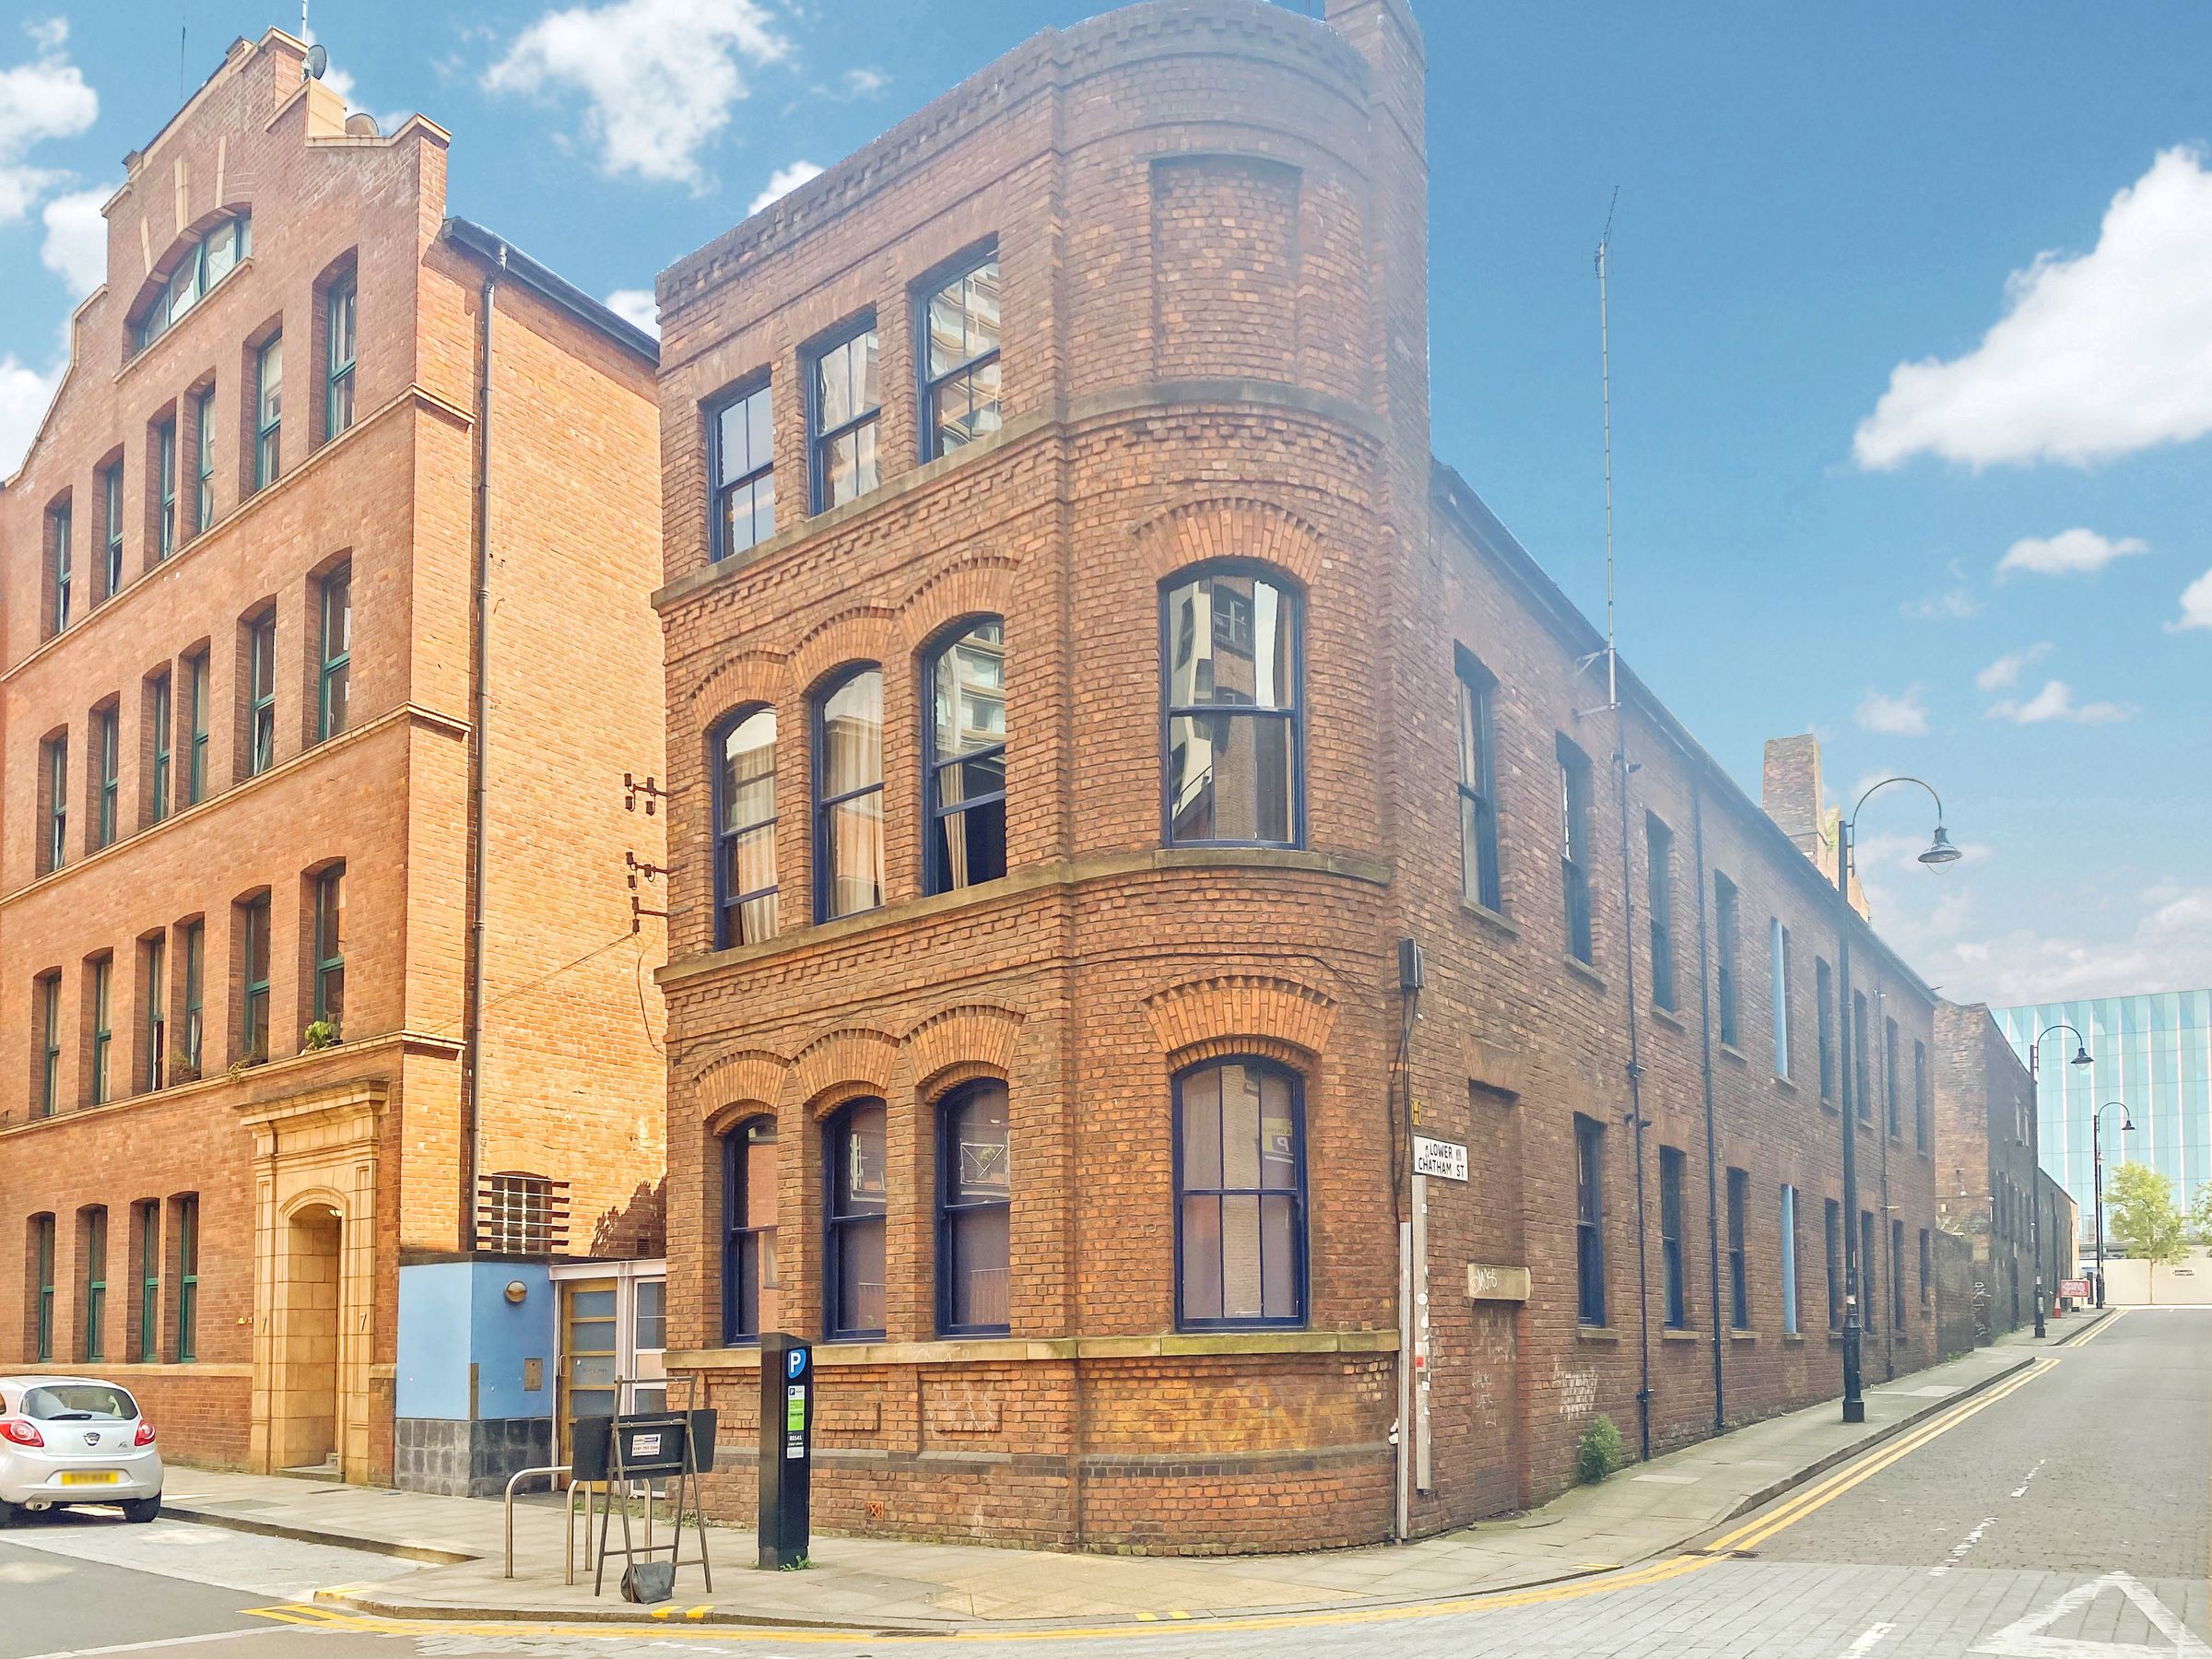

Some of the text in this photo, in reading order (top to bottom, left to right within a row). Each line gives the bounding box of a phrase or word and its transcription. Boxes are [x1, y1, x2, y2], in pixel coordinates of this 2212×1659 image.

[1430, 1142, 1453, 1159] LOWER
[1418, 1158, 1465, 1178] CHATHAM ST
[359, 1312, 367, 1332] 7
[790, 1352, 802, 1373] P
